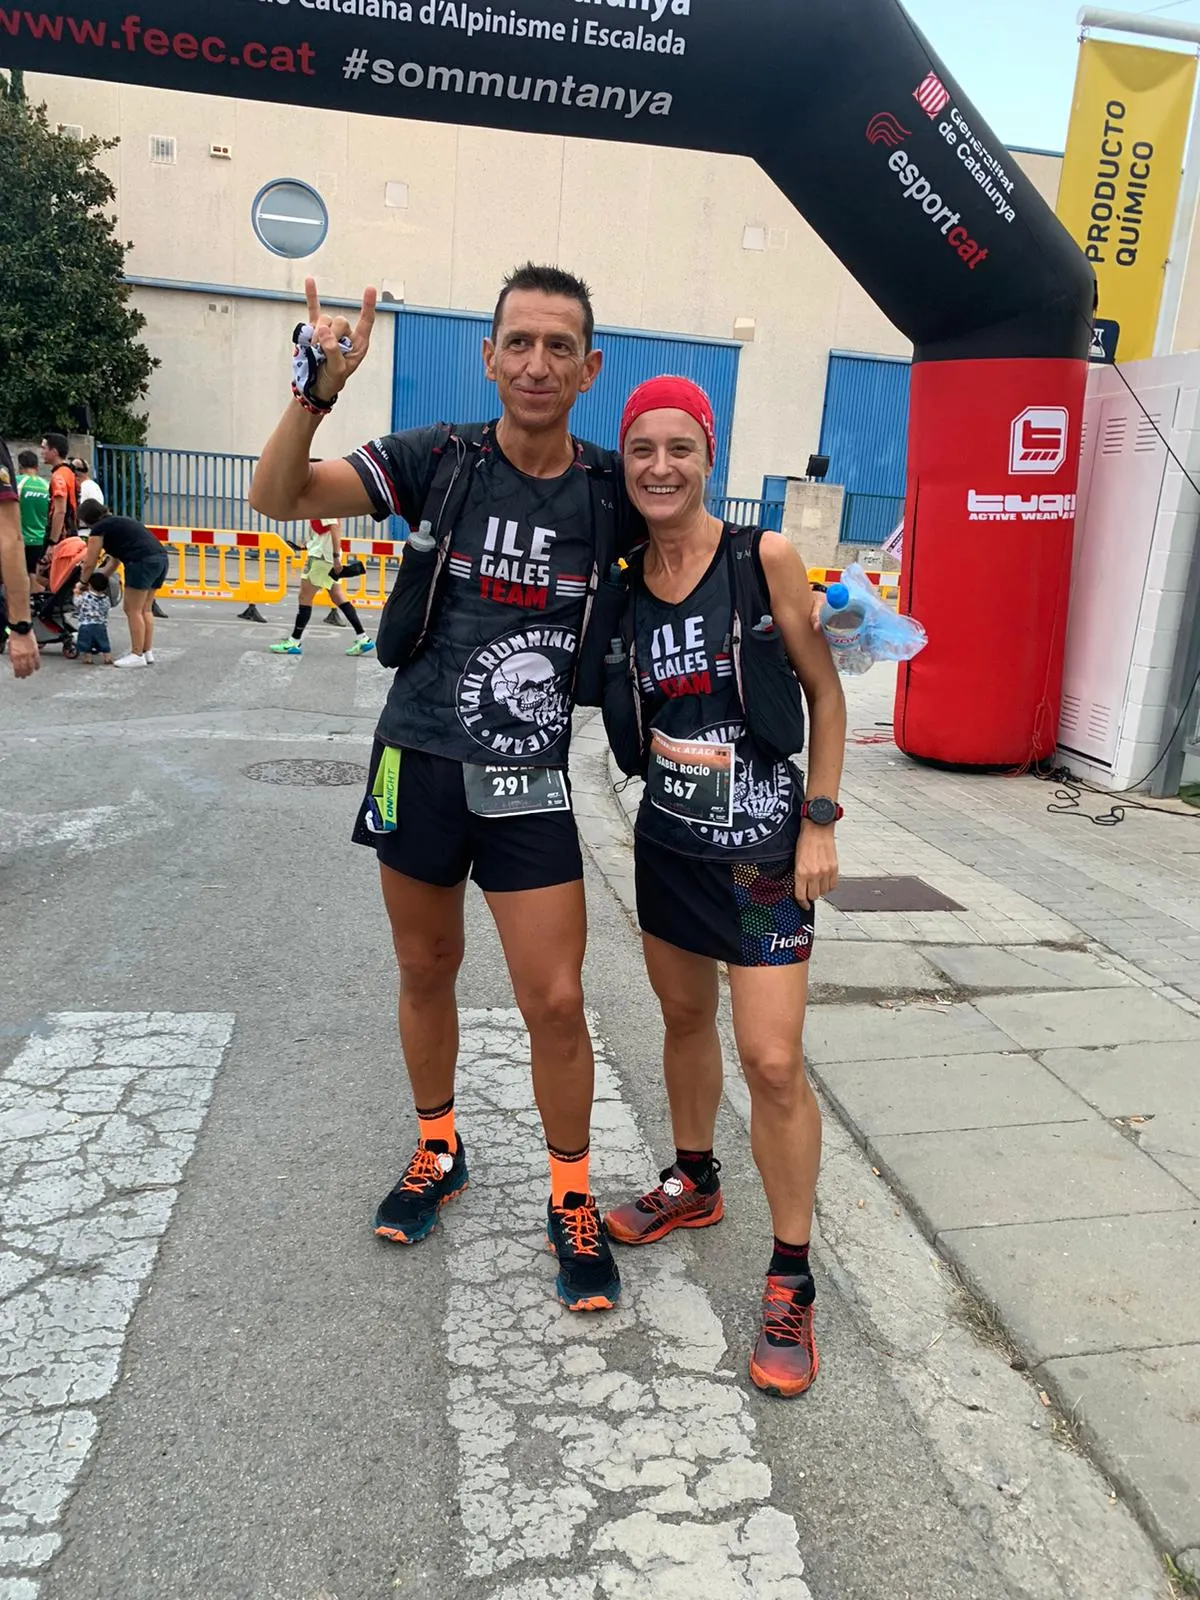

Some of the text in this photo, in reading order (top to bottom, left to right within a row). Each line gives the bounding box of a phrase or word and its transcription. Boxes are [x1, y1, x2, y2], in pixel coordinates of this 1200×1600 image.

[419, 1, 566, 41] d'Alpinisme
[571, 18, 579, 43] i
[584, 20, 686, 55] Escalada
[342, 48, 674, 119] #sommuntanya
[938, 121, 1016, 223] de Catalunya
[1085, 99, 1126, 263] PRODUCTO
[888, 149, 989, 269] esportcat
[1116, 141, 1154, 267] QUÍMICO
[968, 512, 1017, 521] ACTIVE
[1021, 512, 1058, 520] WEAR
[483, 516, 557, 562] ILE
[479, 554, 550, 587] GALES
[479, 576, 549, 611] TEAM
[650, 615, 705, 660] ILE
[653, 650, 708, 681] GALES
[492, 774, 529, 796] 291
[656, 754, 711, 777] ISABEL ROCÍO
[663, 775, 698, 800] 567
[712, 822, 773, 846] TEAM
